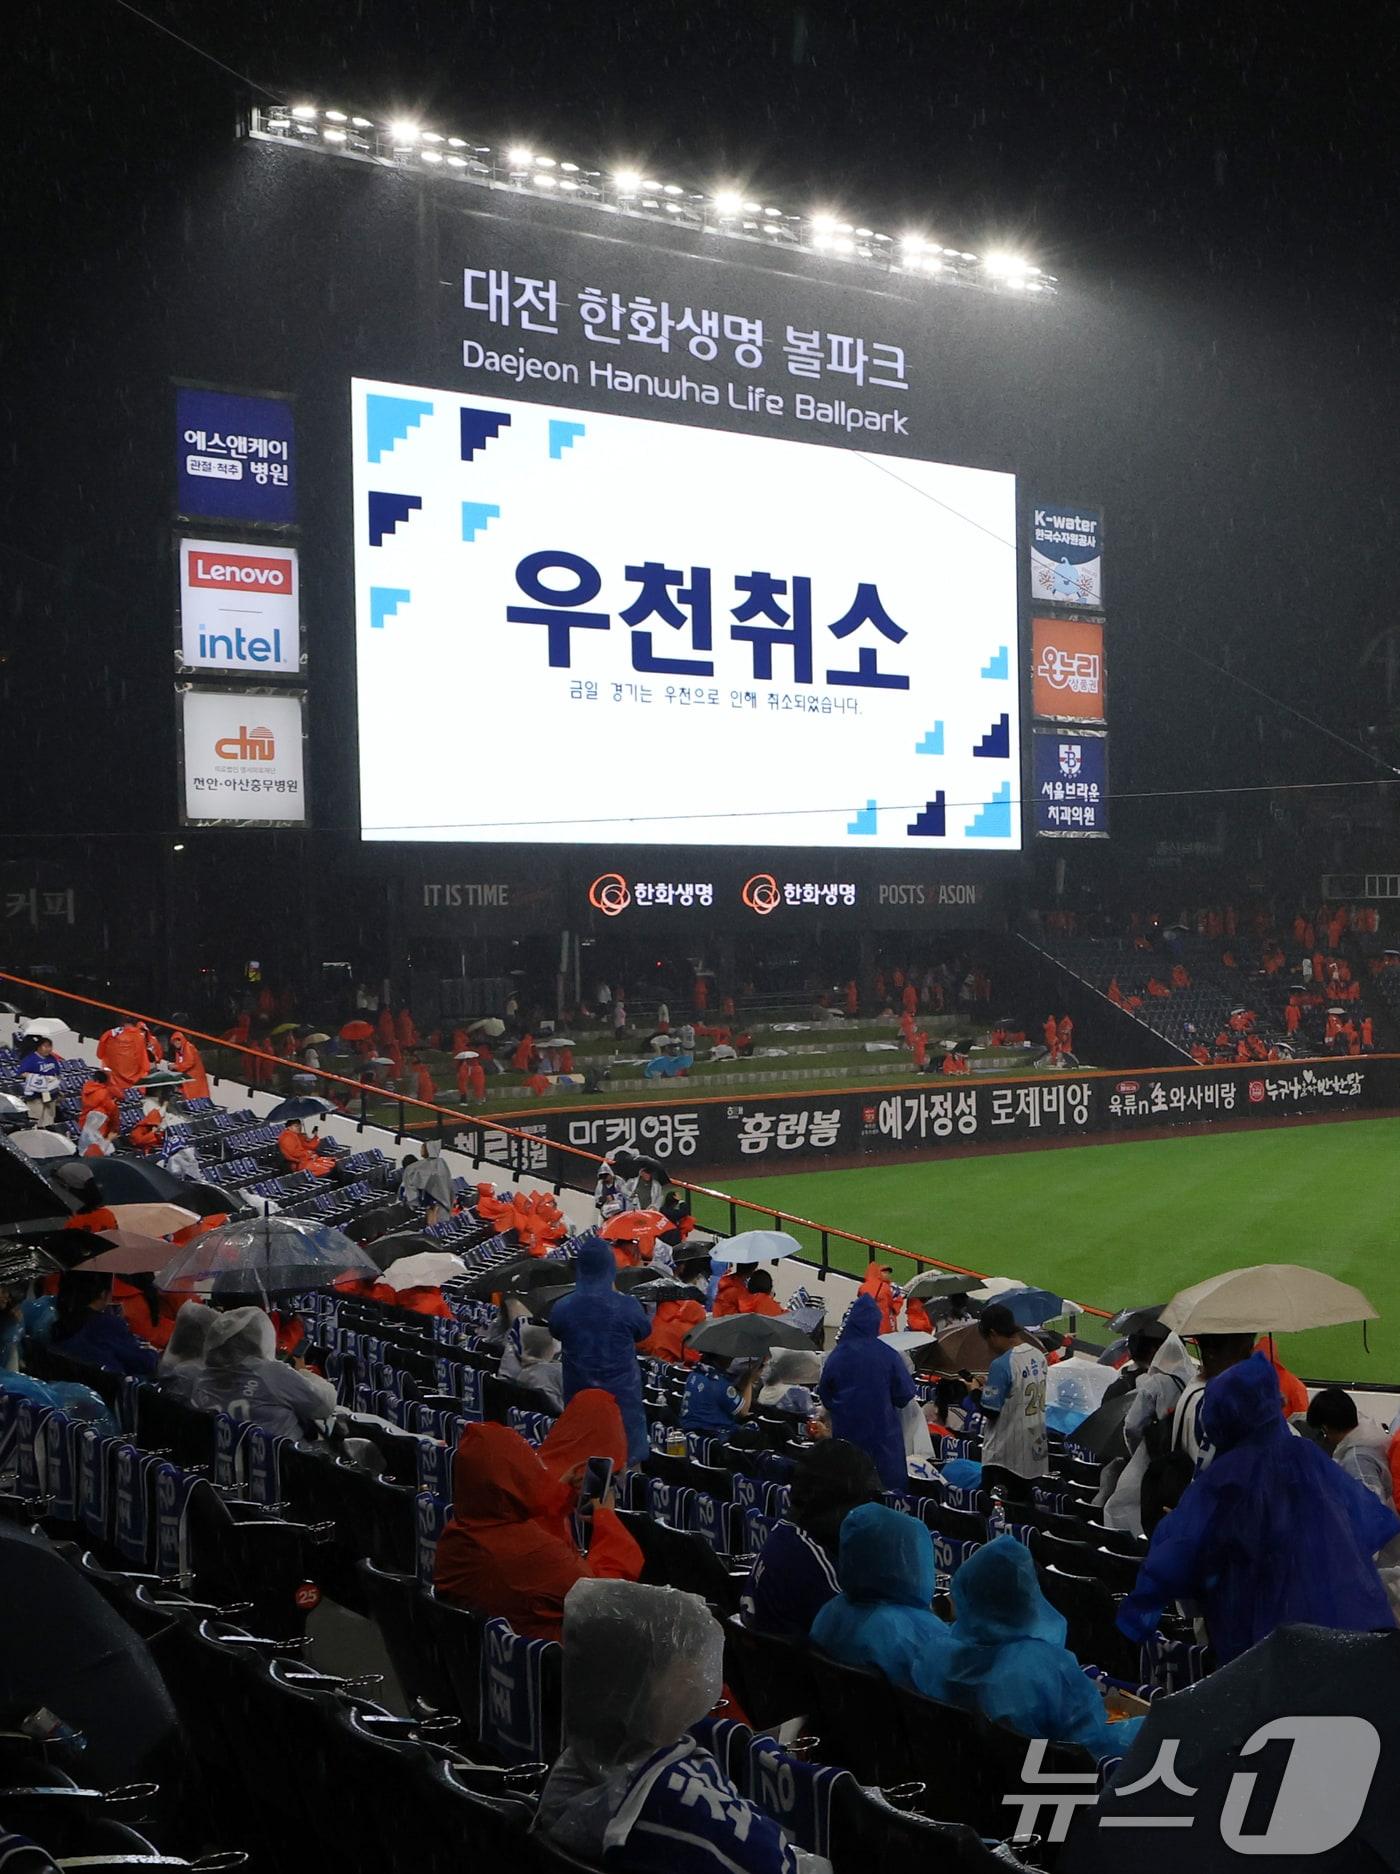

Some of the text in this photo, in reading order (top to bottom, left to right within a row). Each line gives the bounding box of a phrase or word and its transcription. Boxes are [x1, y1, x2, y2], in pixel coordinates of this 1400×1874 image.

[463, 267, 909, 391] 대전 한화생명 볼파크
[462, 339, 909, 436] Daejeon Hanwha Life Ballpark
[184, 429, 288, 461] 에스앤케이
[250, 460, 288, 486] 병원
[1034, 509, 1097, 534] K-water
[196, 558, 285, 587] Lenovo
[506, 550, 910, 690] 우천취소
[198, 623, 282, 664] intel
[569, 680, 863, 715] 금일 경기는 우천으로 인해 취소되었습니다.
[1042, 781, 1100, 803] 서울브라운
[1047, 805, 1095, 826] 치과의원
[423, 884, 510, 907] IT IS TIME
[634, 882, 713, 906] 한화생명
[784, 882, 856, 906] 한화생명
[878, 1083, 1093, 1140] 예가정성 로제비앙
[568, 1112, 701, 1159] 마켓영동
[737, 1108, 841, 1154] 홈런볼
[295, 1588, 318, 1605] 25
